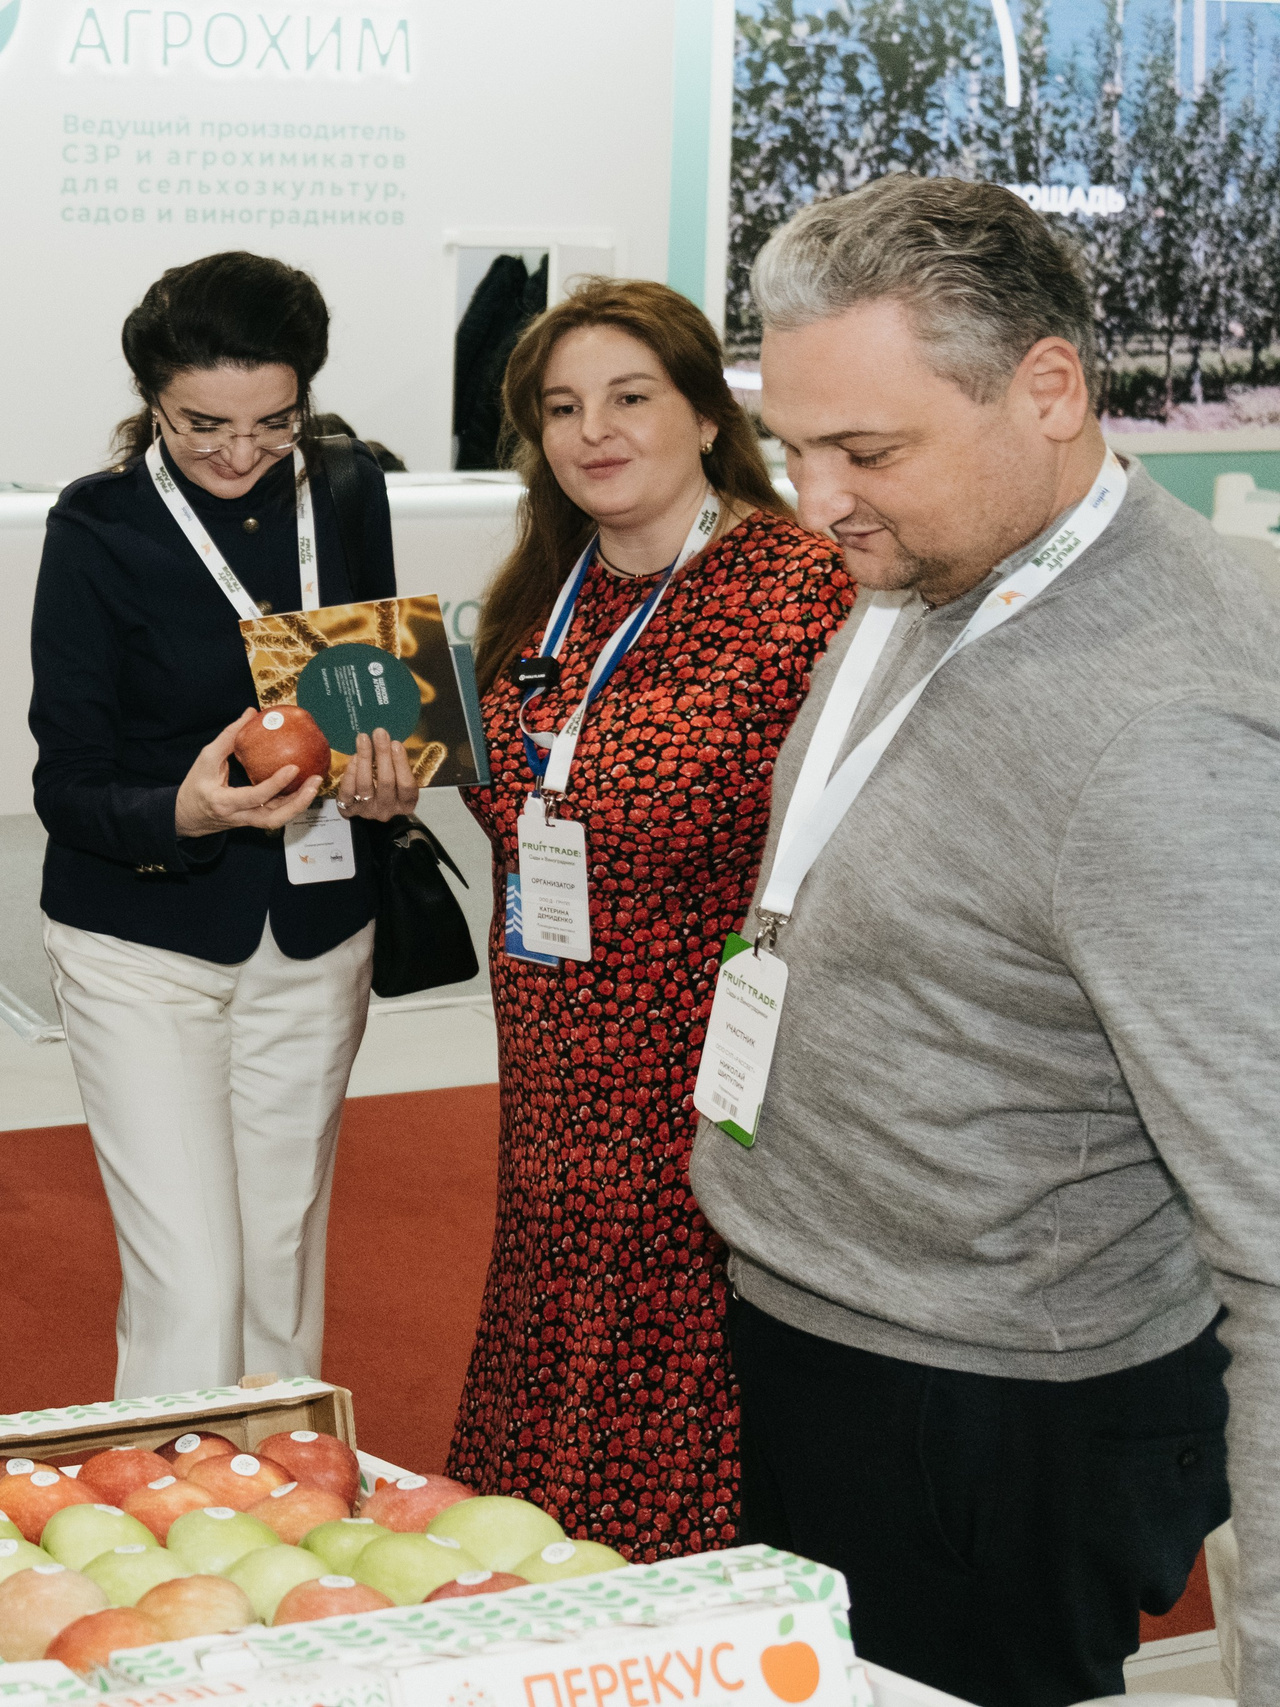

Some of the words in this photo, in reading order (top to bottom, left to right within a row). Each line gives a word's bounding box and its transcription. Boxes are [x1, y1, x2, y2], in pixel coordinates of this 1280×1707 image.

[69, 8, 411, 73] АГРОХИМ
[62, 114, 190, 141] Ведущий
[200, 121, 407, 142] производитель
[61, 143, 121, 165] СЗР
[135, 149, 152, 165] и
[167, 150, 407, 171] агрохимикатов
[60, 177, 119, 196] для
[136, 178, 407, 203] сельхозкультур,
[60, 206, 146, 225] садов
[156, 208, 173, 223] и
[184, 208, 406, 230] виноградников
[531, 877, 575, 890] ОРГАНИЗАТОР
[539, 906, 569, 916] КАТЕРИНА
[725, 1021, 756, 1048] УЧАСТНИК
[719, 1059, 746, 1082] НИКОЛАЙ
[523, 1641, 745, 1707] ПЕРЕКУС
